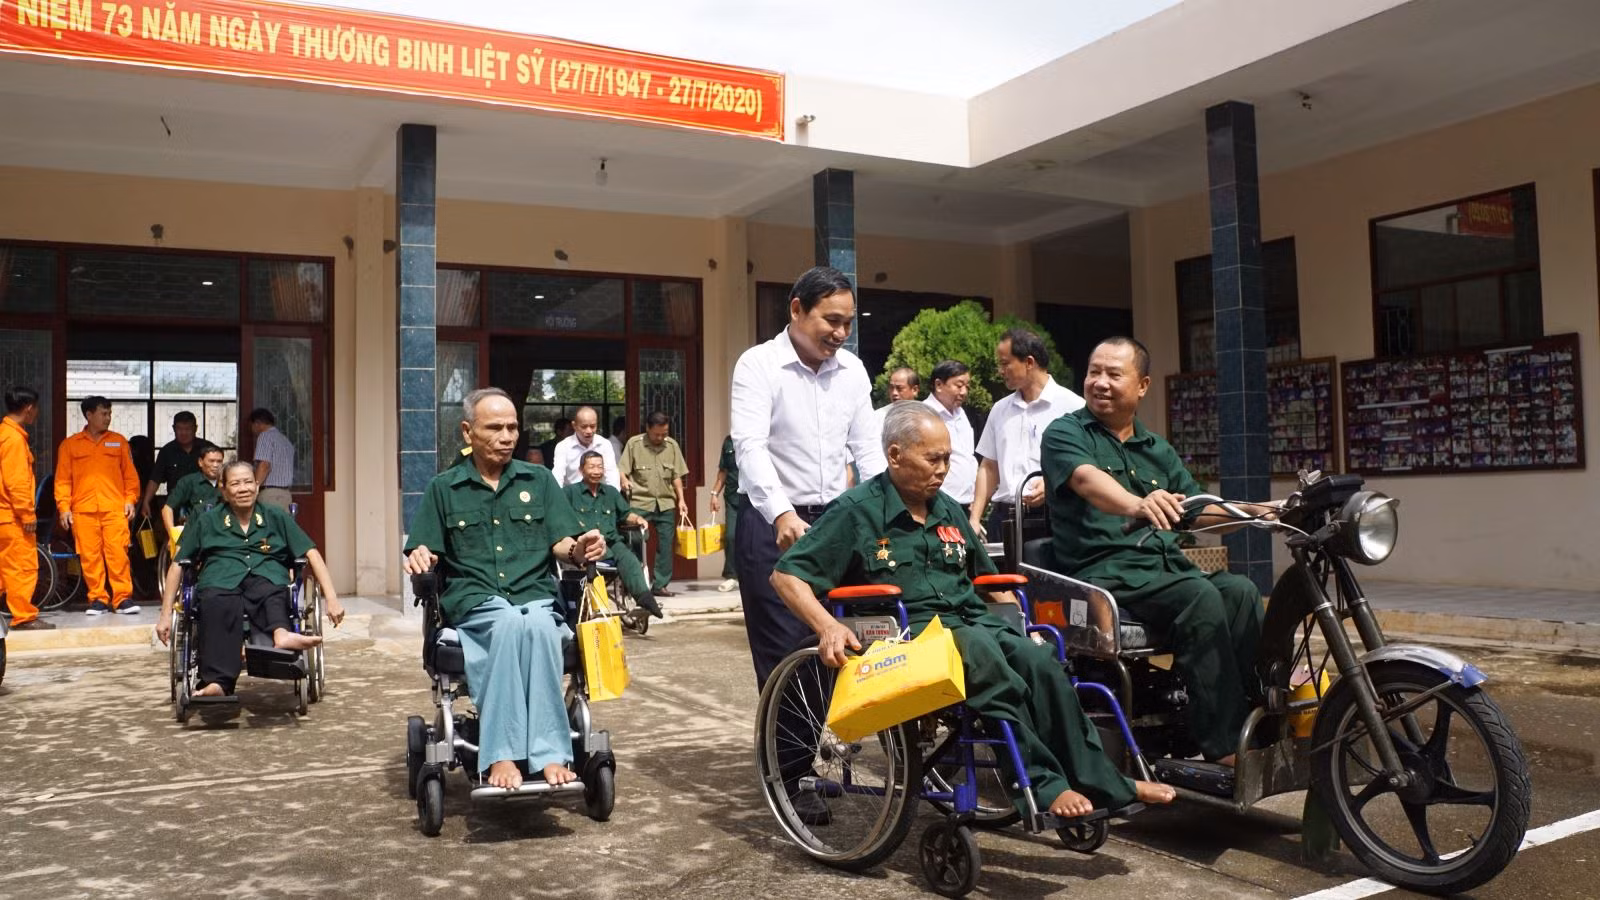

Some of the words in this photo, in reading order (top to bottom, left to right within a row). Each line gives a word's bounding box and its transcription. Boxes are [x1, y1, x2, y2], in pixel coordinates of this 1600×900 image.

[101, 3, 133, 38] 73
[142, 2, 201, 45] NĂM
[209, 11, 282, 54] NGÀY
[288, 24, 390, 67] THƯƠNG
[397, 38, 454, 75] BINH
[461, 42, 511, 89] LIỆT
[516, 48, 545, 86] SỸ
[550, 58, 652, 101] (27/7/1947
[668, 76, 762, 123] 27/7/2020)
[874, 654, 906, 670] năm
